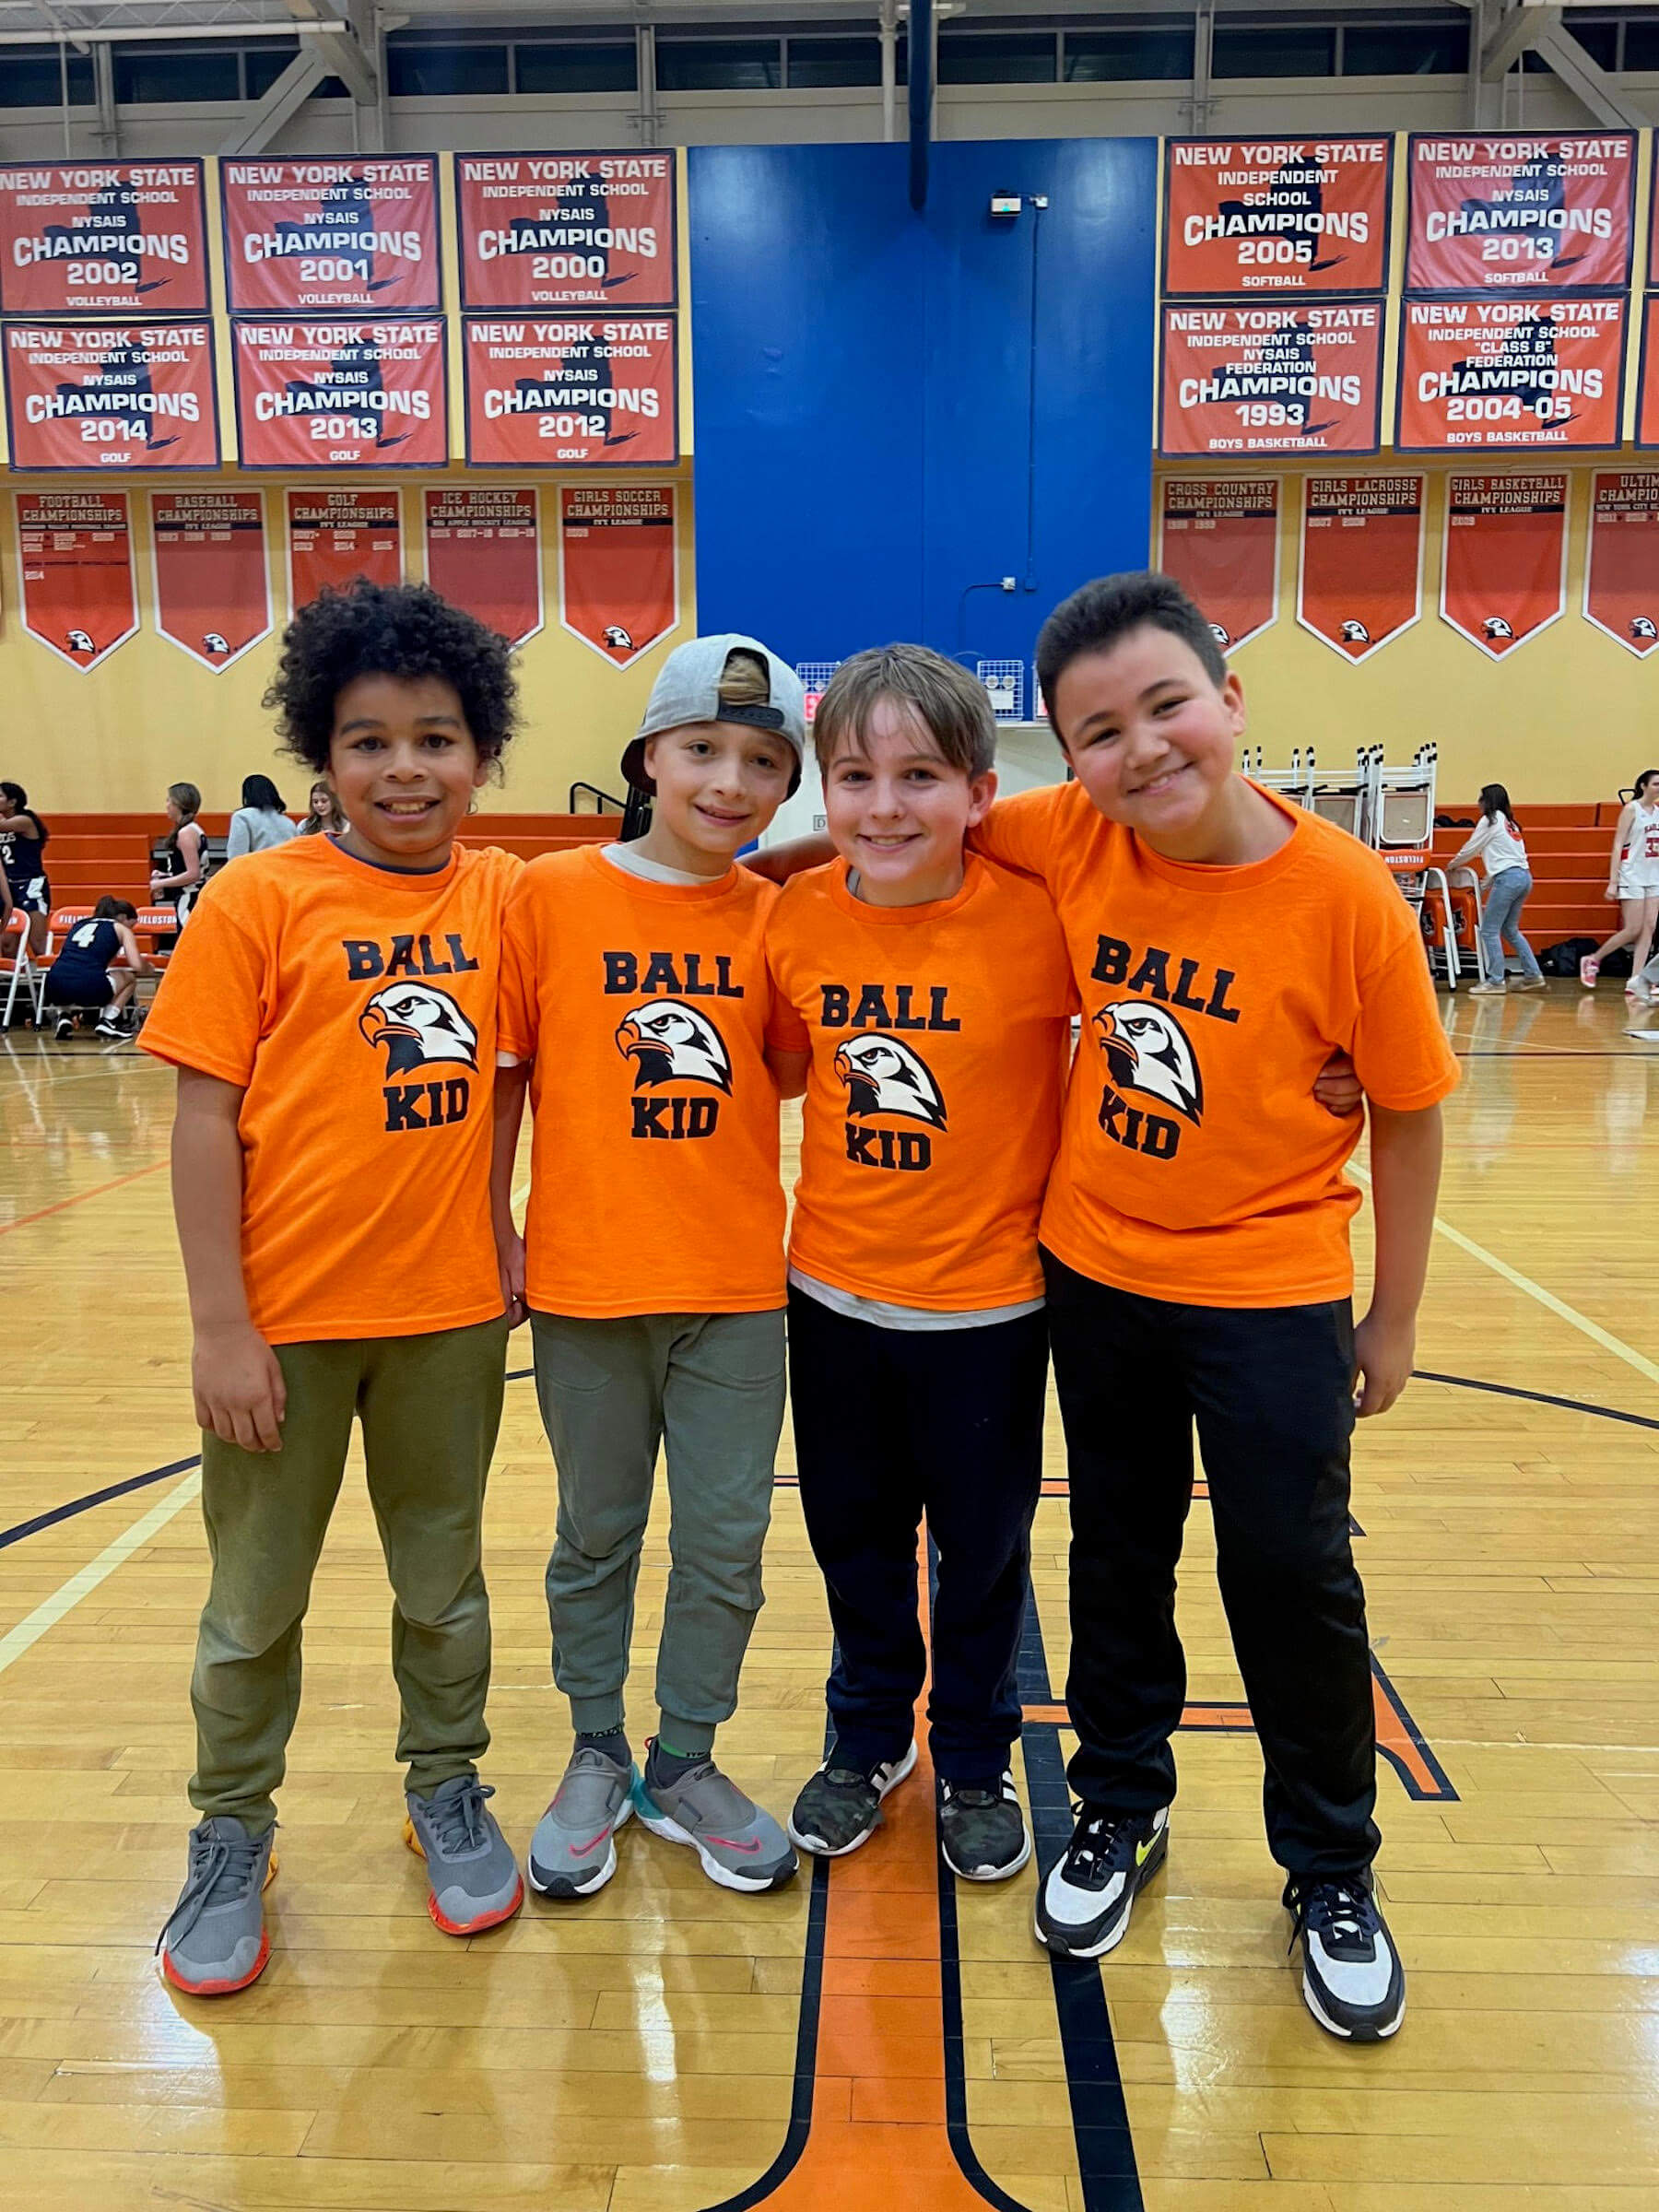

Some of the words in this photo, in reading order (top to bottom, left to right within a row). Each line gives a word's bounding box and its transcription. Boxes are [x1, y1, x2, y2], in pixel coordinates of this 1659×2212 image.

[1175, 147, 1231, 166] NEW
[1243, 145, 1305, 164] YORK
[1314, 144, 1383, 163] STATE
[1418, 143, 1475, 161] NEW
[1485, 142, 1548, 160] YORK
[1559, 140, 1628, 159] STATE
[230, 166, 283, 184] NEW
[292, 165, 355, 183] YORK
[363, 163, 429, 182] STATE
[465, 162, 519, 181] NEW
[528, 161, 590, 180] YORK
[600, 159, 666, 179] STATE
[1436, 165, 1542, 178] INDEPENDENT
[1547, 164, 1607, 176] SCHOOL
[0, 171, 51, 190] NEW
[60, 170, 119, 188] YORK
[129, 167, 195, 186] STATE
[1218, 170, 1338, 185] INDEPENDENT
[247, 187, 347, 201] INDEPENDENT
[353, 187, 413, 200] SCHOOL
[483, 185, 584, 197] INDEPENDENT
[590, 183, 649, 196] SCHOOL
[1492, 190, 1549, 202] NYSAIS
[17, 193, 115, 206] INDEPENDENT
[121, 191, 179, 204] SCHOOL
[1243, 192, 1312, 206] SCHOOL
[72, 216, 126, 228] NYSAIS
[303, 212, 359, 224] NYSAIS
[538, 209, 594, 221] NYSAIS
[1184, 212, 1369, 246] CHAMPIONS
[1427, 208, 1612, 241] CHAMPIONS
[13, 234, 189, 267] CHAMPIONS
[243, 231, 421, 264] CHAMPIONS
[478, 227, 657, 260] CHAMPIONS
[1482, 238, 1554, 261] 2013
[1238, 241, 1312, 264] 2005
[66, 262, 138, 285] 2002
[300, 259, 369, 281] 2001
[533, 256, 606, 278] 2000
[1241, 276, 1305, 287] SOFTBALL
[1484, 273, 1549, 283] SOFTBALL
[66, 296, 142, 306] VOLLEYBALL
[298, 293, 374, 304] VOLLEYBALL
[532, 290, 607, 301] VOLLEYBALL
[1171, 312, 1226, 331] NEW
[1235, 312, 1298, 329] YORK
[1308, 309, 1375, 327] STATE
[1411, 306, 1466, 324] NEW
[1478, 305, 1541, 323] YORK
[1550, 303, 1619, 321] STATE
[11, 331, 63, 348] NEW
[73, 330, 132, 347] YORK
[141, 328, 206, 346] STATE
[241, 327, 293, 346] NEW
[302, 326, 364, 345] YORK
[373, 325, 438, 343] STATE
[472, 324, 525, 342] NEW
[535, 324, 594, 342] YORK
[604, 323, 668, 341] STATE
[1429, 329, 1534, 341] INDEPENDENT
[1538, 326, 1600, 338] SCHOOL
[1187, 335, 1291, 347] INDEPENDENT
[1296, 333, 1356, 345] SCHOOL
[29, 352, 126, 364] INDEPENDENT
[132, 351, 189, 363] SCHOOL
[259, 348, 359, 361] INDEPENDENT
[363, 347, 421, 360] SCHOOL
[489, 347, 589, 359] INDEPENDENT
[594, 347, 652, 358] SCHOOL
[1244, 348, 1300, 360] NYSAIS
[1226, 361, 1316, 374] FEDERATION
[1466, 354, 1558, 368] FEDERATION
[83, 374, 136, 385] NYSAIS
[313, 371, 369, 383] NYSAIS
[544, 370, 598, 382] NYSAIS
[1179, 376, 1360, 408] CHAMPIONS
[1418, 369, 1603, 402] CHAMPIONS
[26, 393, 199, 424] CHAMPIONS
[254, 390, 430, 422] CHAMPIONS
[485, 388, 659, 421] CHAMPIONS
[1446, 397, 1571, 421] 2004-05
[1236, 405, 1304, 427] 1993
[81, 420, 148, 441] 2014
[311, 417, 378, 440] 2013
[538, 416, 606, 438] 2012
[1209, 439, 1243, 449] BOYS
[1248, 437, 1327, 448] BASKETBALL
[1447, 432, 1482, 442] BOYS
[1487, 431, 1568, 442] BASKETBALL
[100, 453, 132, 463] GOLF
[330, 450, 360, 461] GOLF
[558, 449, 588, 458] GOLF
[1168, 484, 1207, 495] CROSS
[1215, 483, 1275, 495] COUNTRY
[1312, 480, 1347, 492] GIRLS
[1355, 479, 1418, 491] LACROSSE
[1453, 479, 1485, 490] GIRLS
[1491, 477, 1564, 489] BASKETBALL
[40, 496, 104, 508] FOOTBALL
[175, 496, 238, 508] BASEBALL
[328, 494, 359, 506] GOLF
[443, 493, 463, 503] ICE
[469, 492, 518, 503] HOCKEY
[574, 491, 609, 502] GIRLS
[616, 490, 661, 502] SOCCER
[1169, 496, 1272, 509] CHAMPIONSHIPS
[1312, 493, 1417, 506] CHAMPIONSHIPS
[1454, 491, 1560, 504] CHAMPIONSHIPS
[23, 509, 123, 522] CHAMPIONSHIPS
[158, 509, 258, 521] CHAMPIONSHIPS
[295, 508, 394, 519] CHAMPIONSHIPS
[430, 505, 531, 517] CHAMPIONSHIPS
[568, 504, 668, 516] CHAMPIONSHIPS
[72, 924, 99, 947] 4
[342, 934, 479, 981] BALL
[603, 951, 744, 998] BALL
[1090, 935, 1241, 1023] BALL
[820, 984, 960, 1031] BALL
[382, 1077, 470, 1132] KID
[631, 1097, 720, 1140] KID
[1099, 1085, 1182, 1160] KID
[845, 1123, 931, 1171] KID
